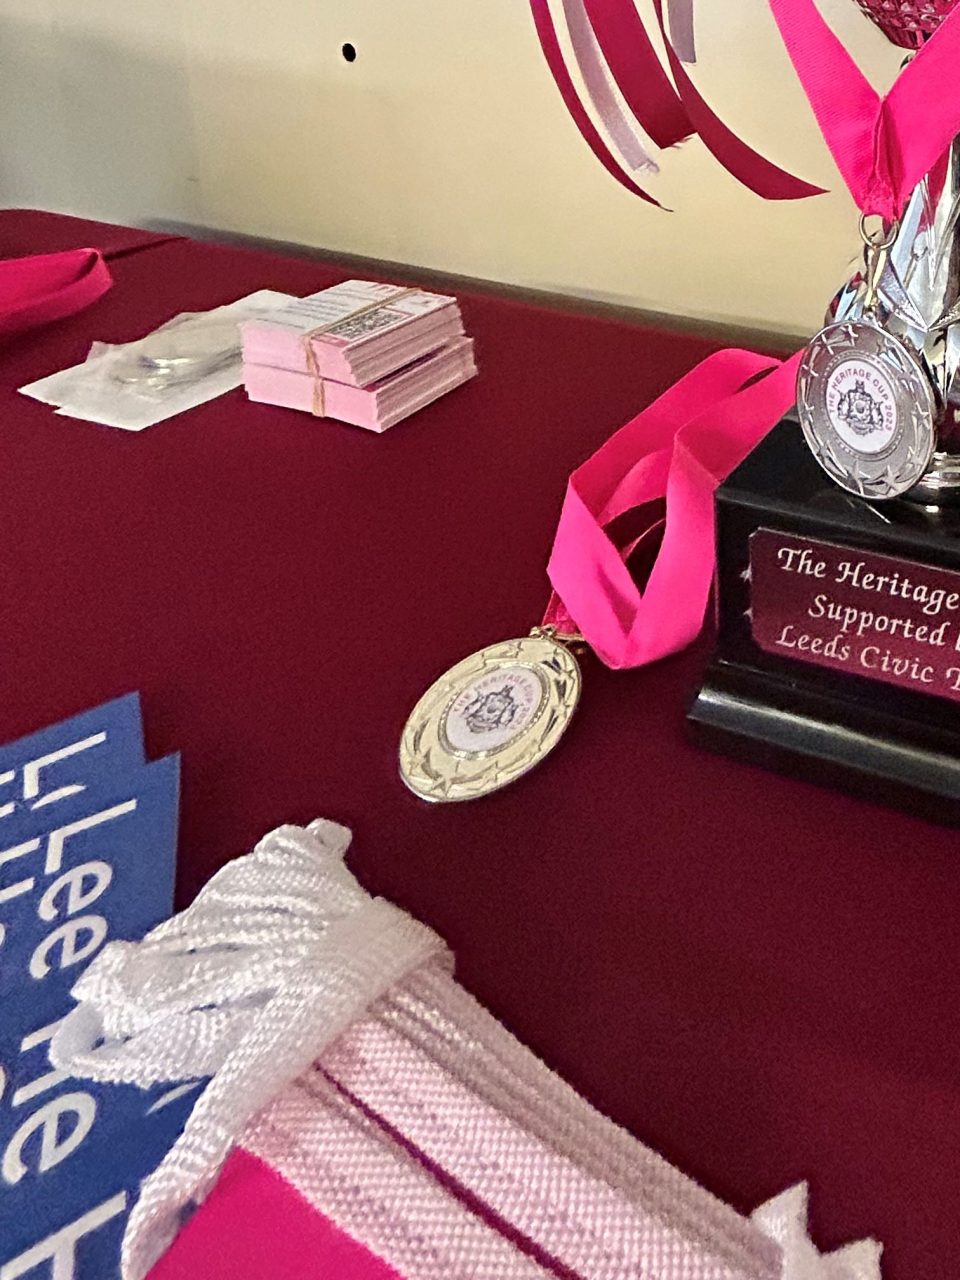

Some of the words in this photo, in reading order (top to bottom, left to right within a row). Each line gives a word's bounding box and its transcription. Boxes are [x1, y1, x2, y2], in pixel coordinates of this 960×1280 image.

[777, 547, 827, 579] The
[835, 561, 960, 615] Heritage
[808, 594, 951, 647] Supported
[776, 625, 851, 662] Leeds
[860, 645, 934, 683] Civic
